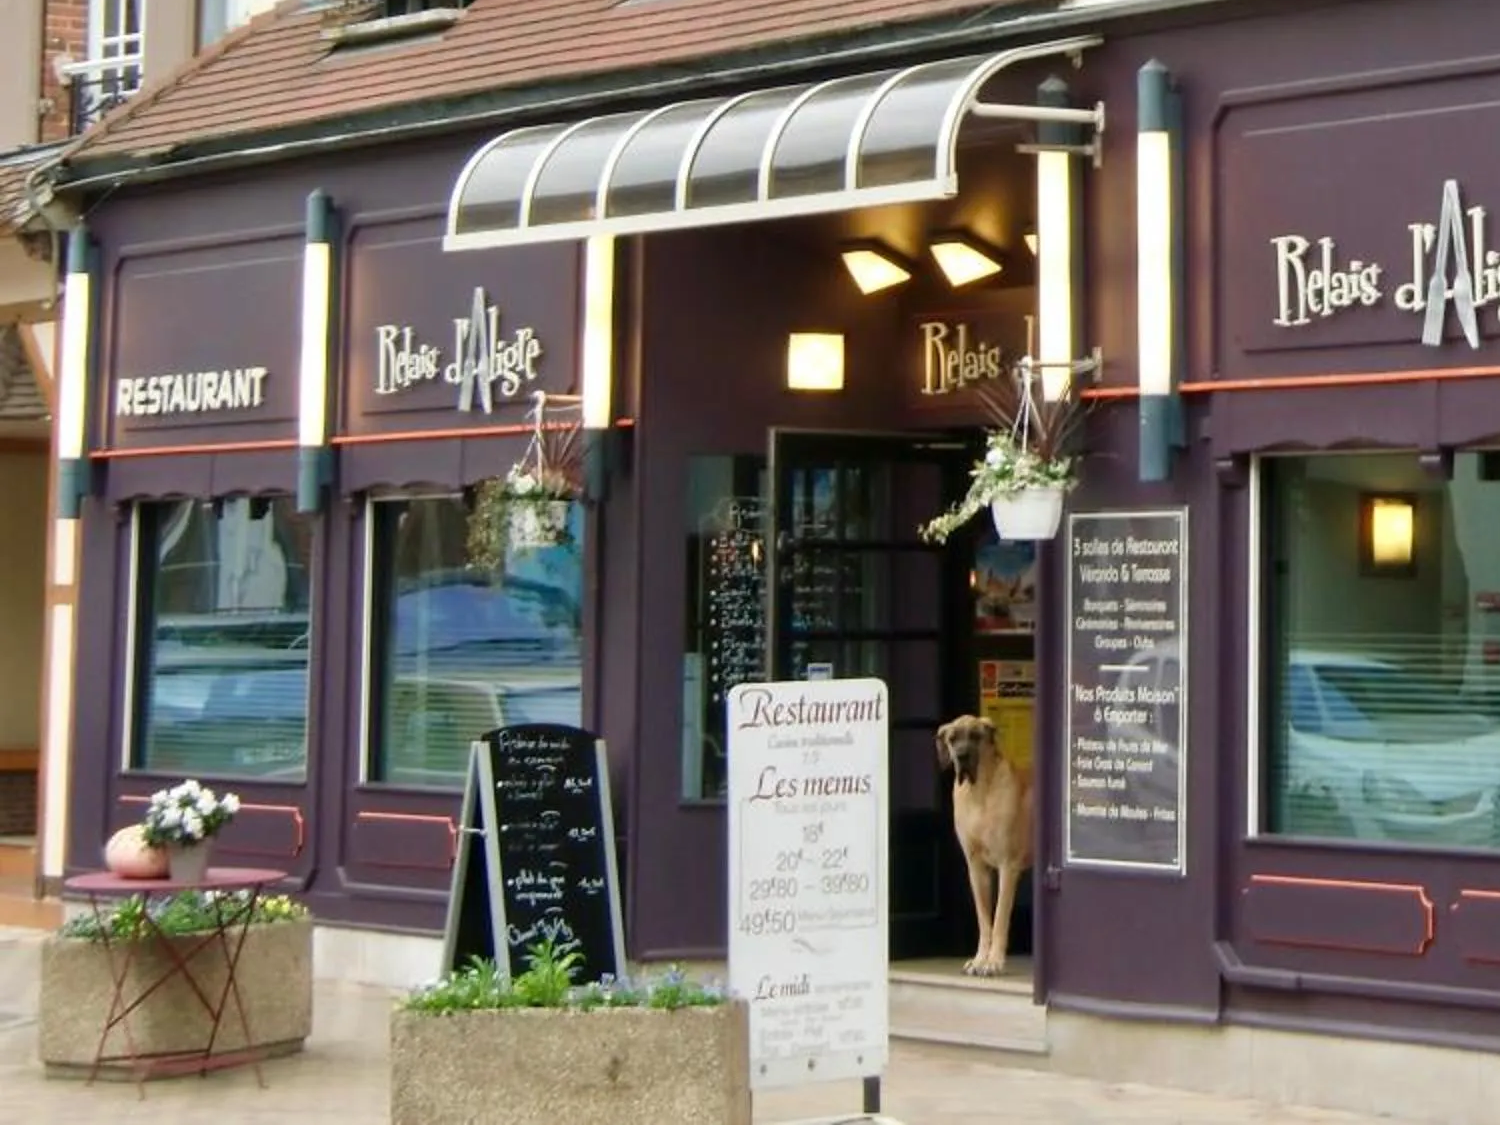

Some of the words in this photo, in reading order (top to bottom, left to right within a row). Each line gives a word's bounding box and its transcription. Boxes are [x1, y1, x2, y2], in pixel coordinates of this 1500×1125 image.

[1270, 234, 1383, 326] Relais
[375, 324, 440, 394] Relais
[444, 286, 543, 414] d'Aligre
[920, 322, 1001, 395] Relais
[116, 367, 268, 416] RESTAURANT
[737, 688, 883, 731] Restaurant
[750, 765, 798, 803] Les
[803, 773, 872, 797] menus
